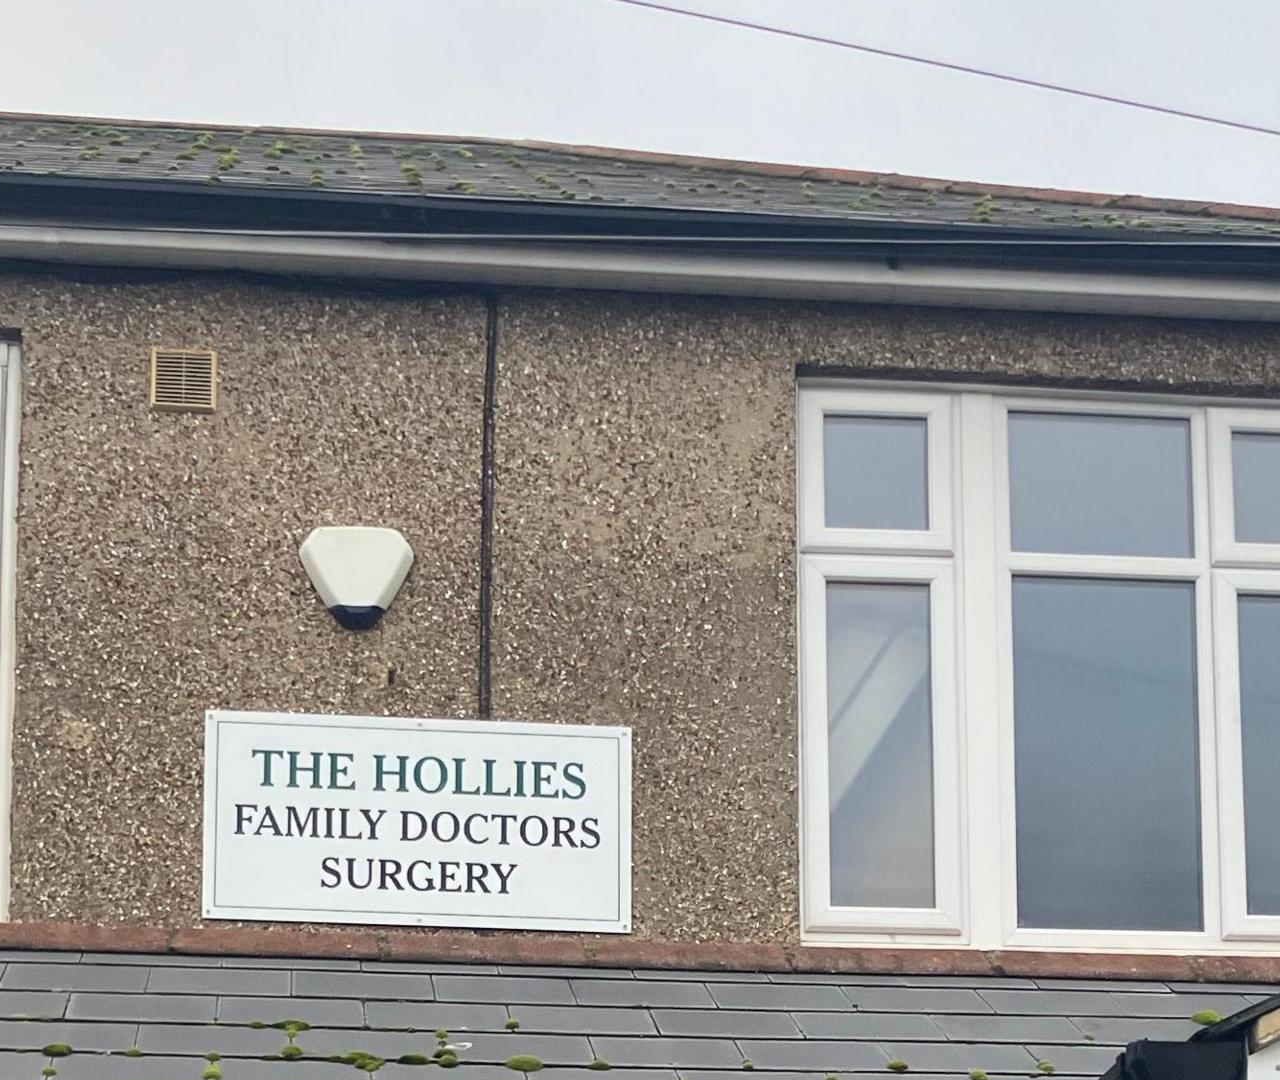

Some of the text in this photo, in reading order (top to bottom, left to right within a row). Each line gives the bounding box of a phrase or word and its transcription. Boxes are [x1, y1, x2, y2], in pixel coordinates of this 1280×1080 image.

[251, 748, 587, 800] THE HOLLIES
[234, 804, 600, 849] FAMILY DOCTORS
[320, 857, 518, 895] SURGERY
